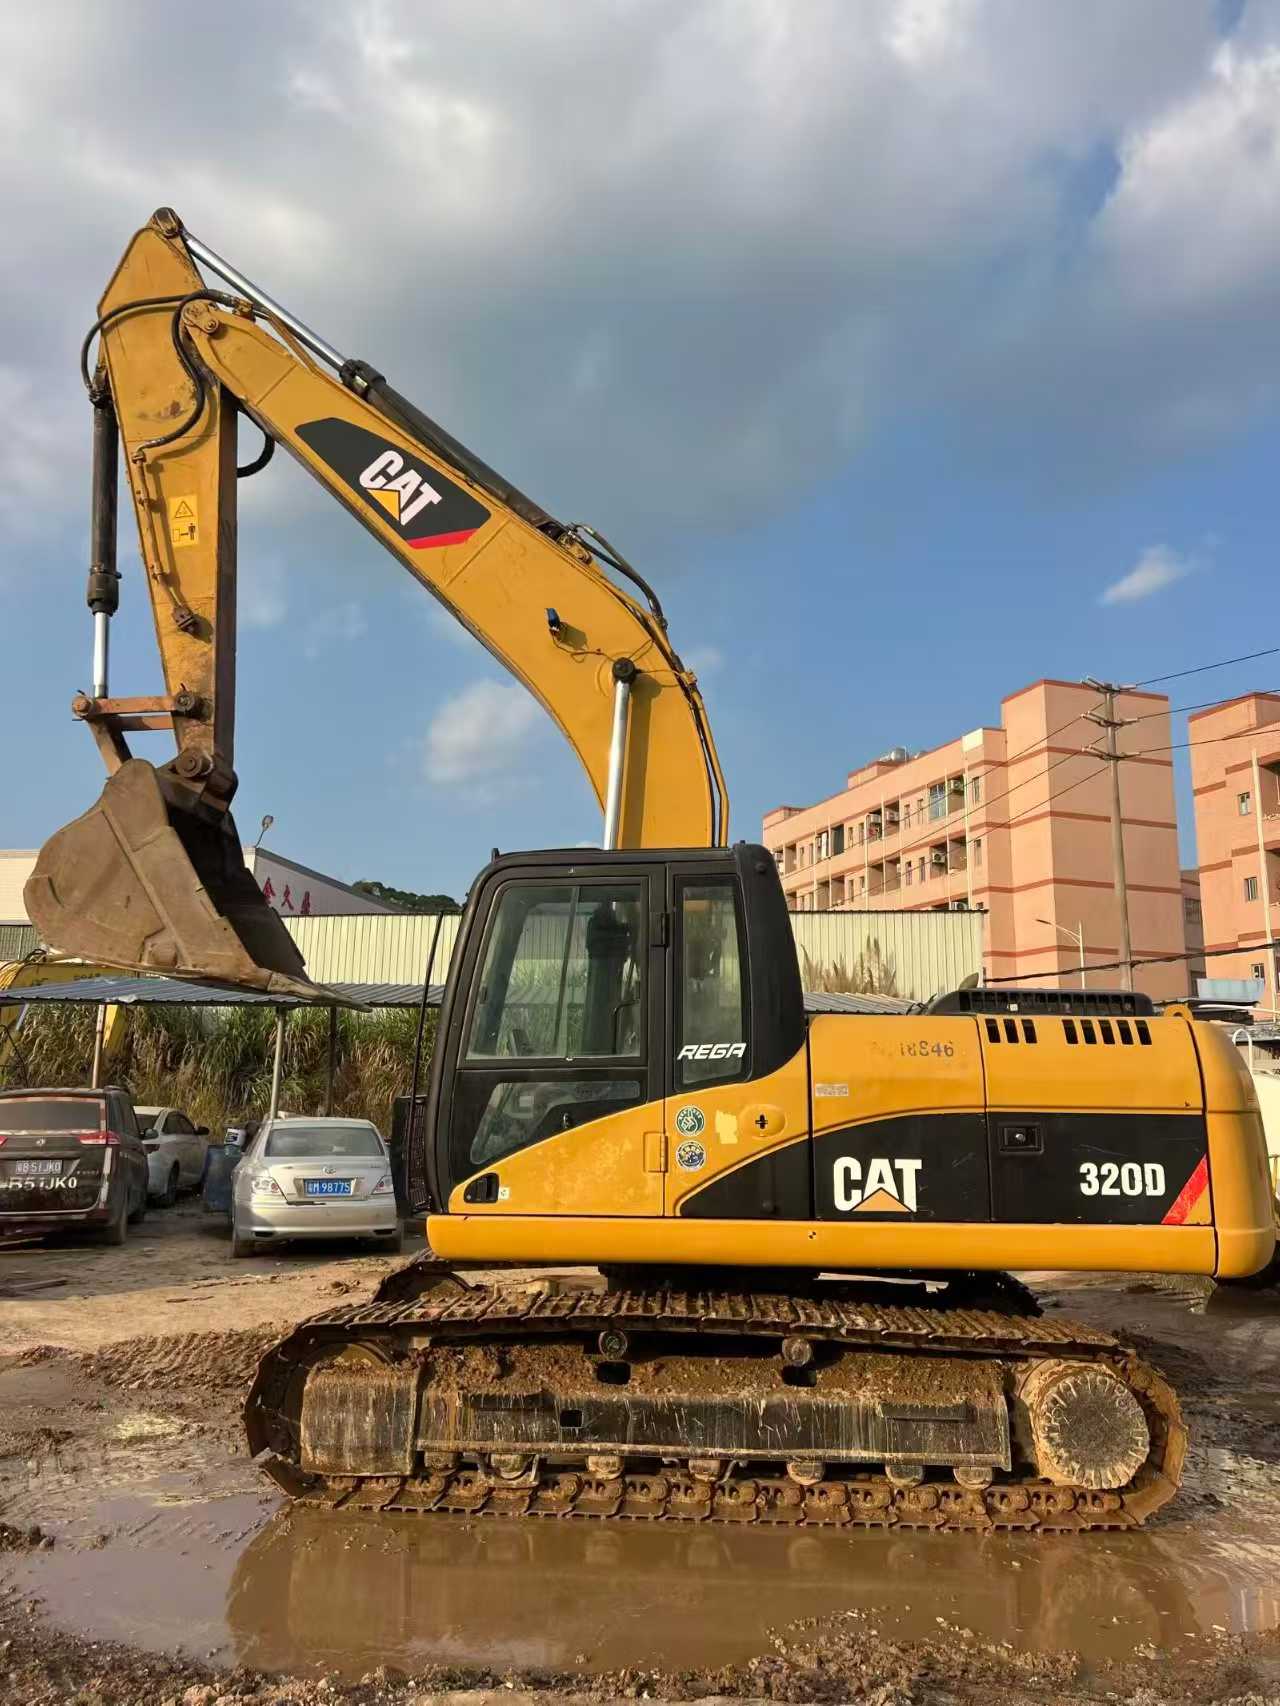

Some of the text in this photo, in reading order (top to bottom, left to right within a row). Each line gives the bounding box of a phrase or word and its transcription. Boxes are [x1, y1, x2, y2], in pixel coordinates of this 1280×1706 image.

[359, 450, 442, 526] CAT
[676, 1042, 747, 1060] REGA
[833, 1156, 922, 1212] CAT
[1079, 1162, 1166, 1196] 320D
